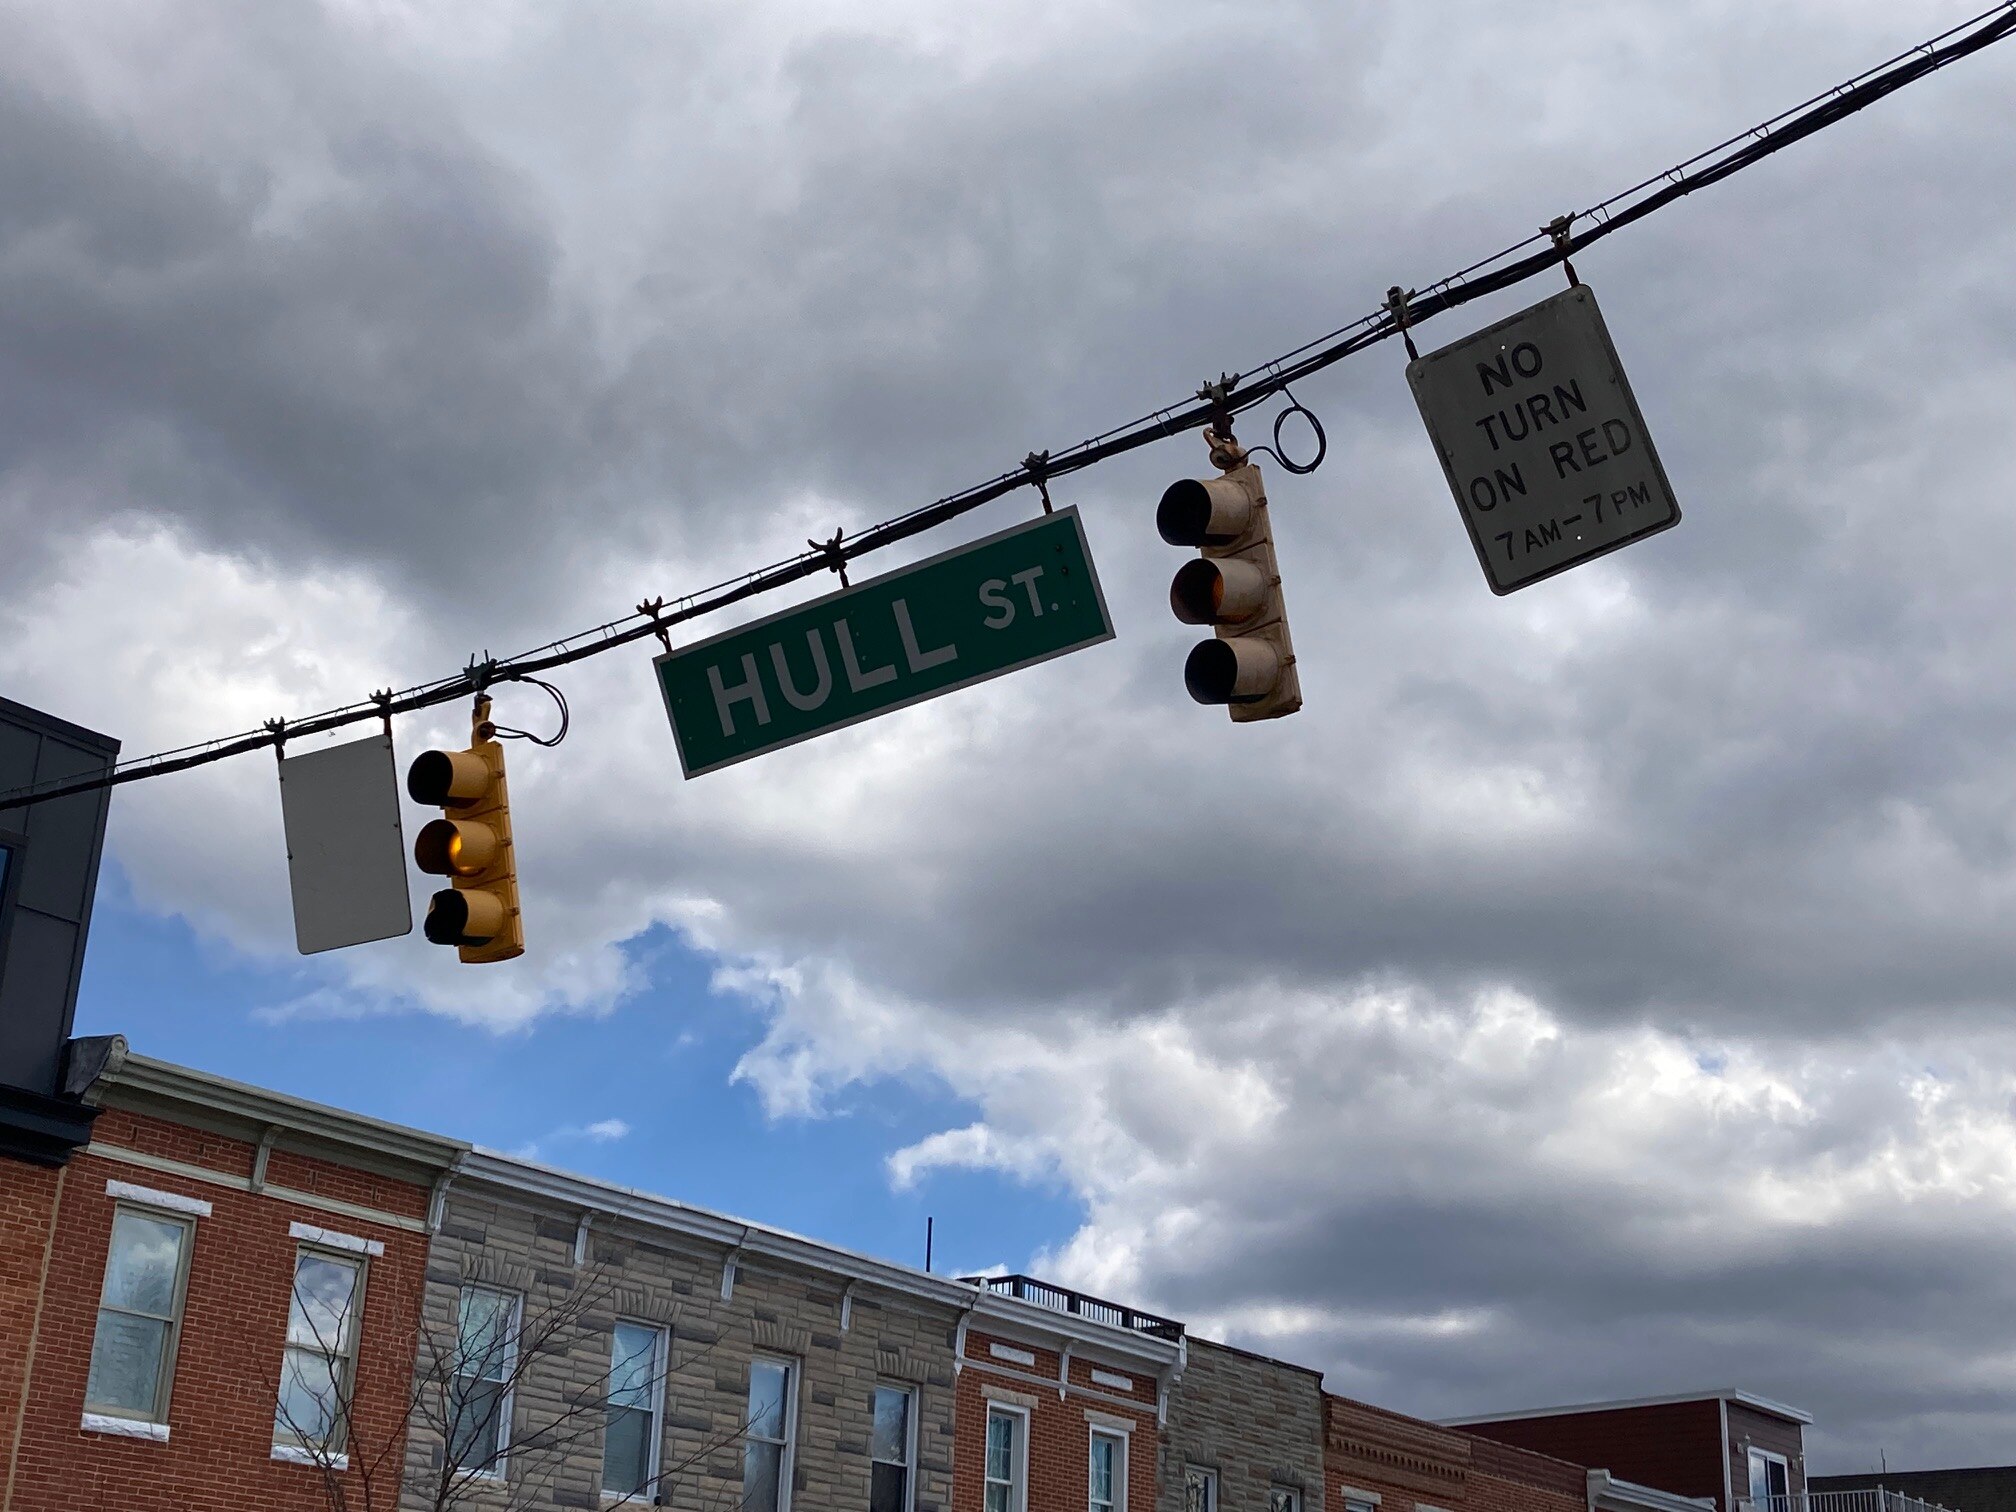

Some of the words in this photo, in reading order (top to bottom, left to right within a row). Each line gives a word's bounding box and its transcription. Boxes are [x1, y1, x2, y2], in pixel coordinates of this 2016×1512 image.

[1476, 341, 1543, 396] NO
[1475, 378, 1587, 451] TURN
[1469, 462, 1527, 512] ON
[1548, 418, 1631, 479] RED
[706, 598, 959, 738] HULL
[978, 565, 1060, 630] ST.
